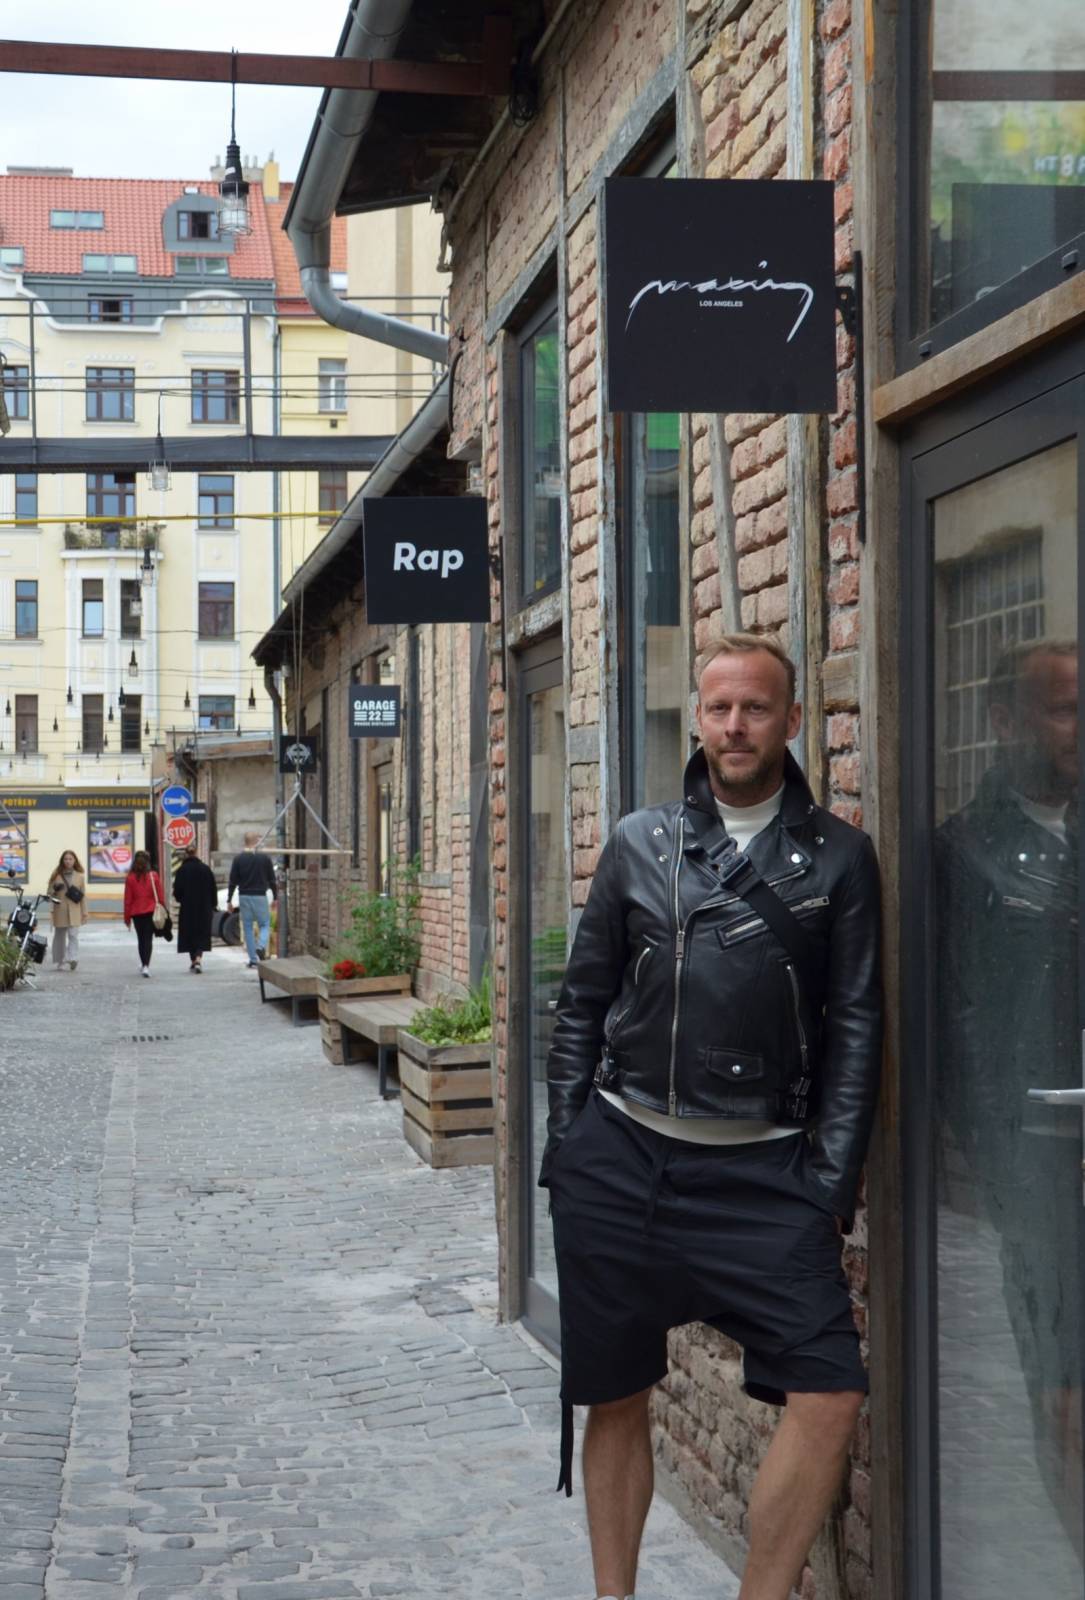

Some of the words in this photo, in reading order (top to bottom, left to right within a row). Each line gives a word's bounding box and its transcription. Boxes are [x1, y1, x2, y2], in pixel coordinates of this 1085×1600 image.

[393, 542, 464, 578] Rap
[354, 700, 396, 710] GARAGE
[368, 711, 381, 721] 22
[168, 826, 192, 840] STOP
